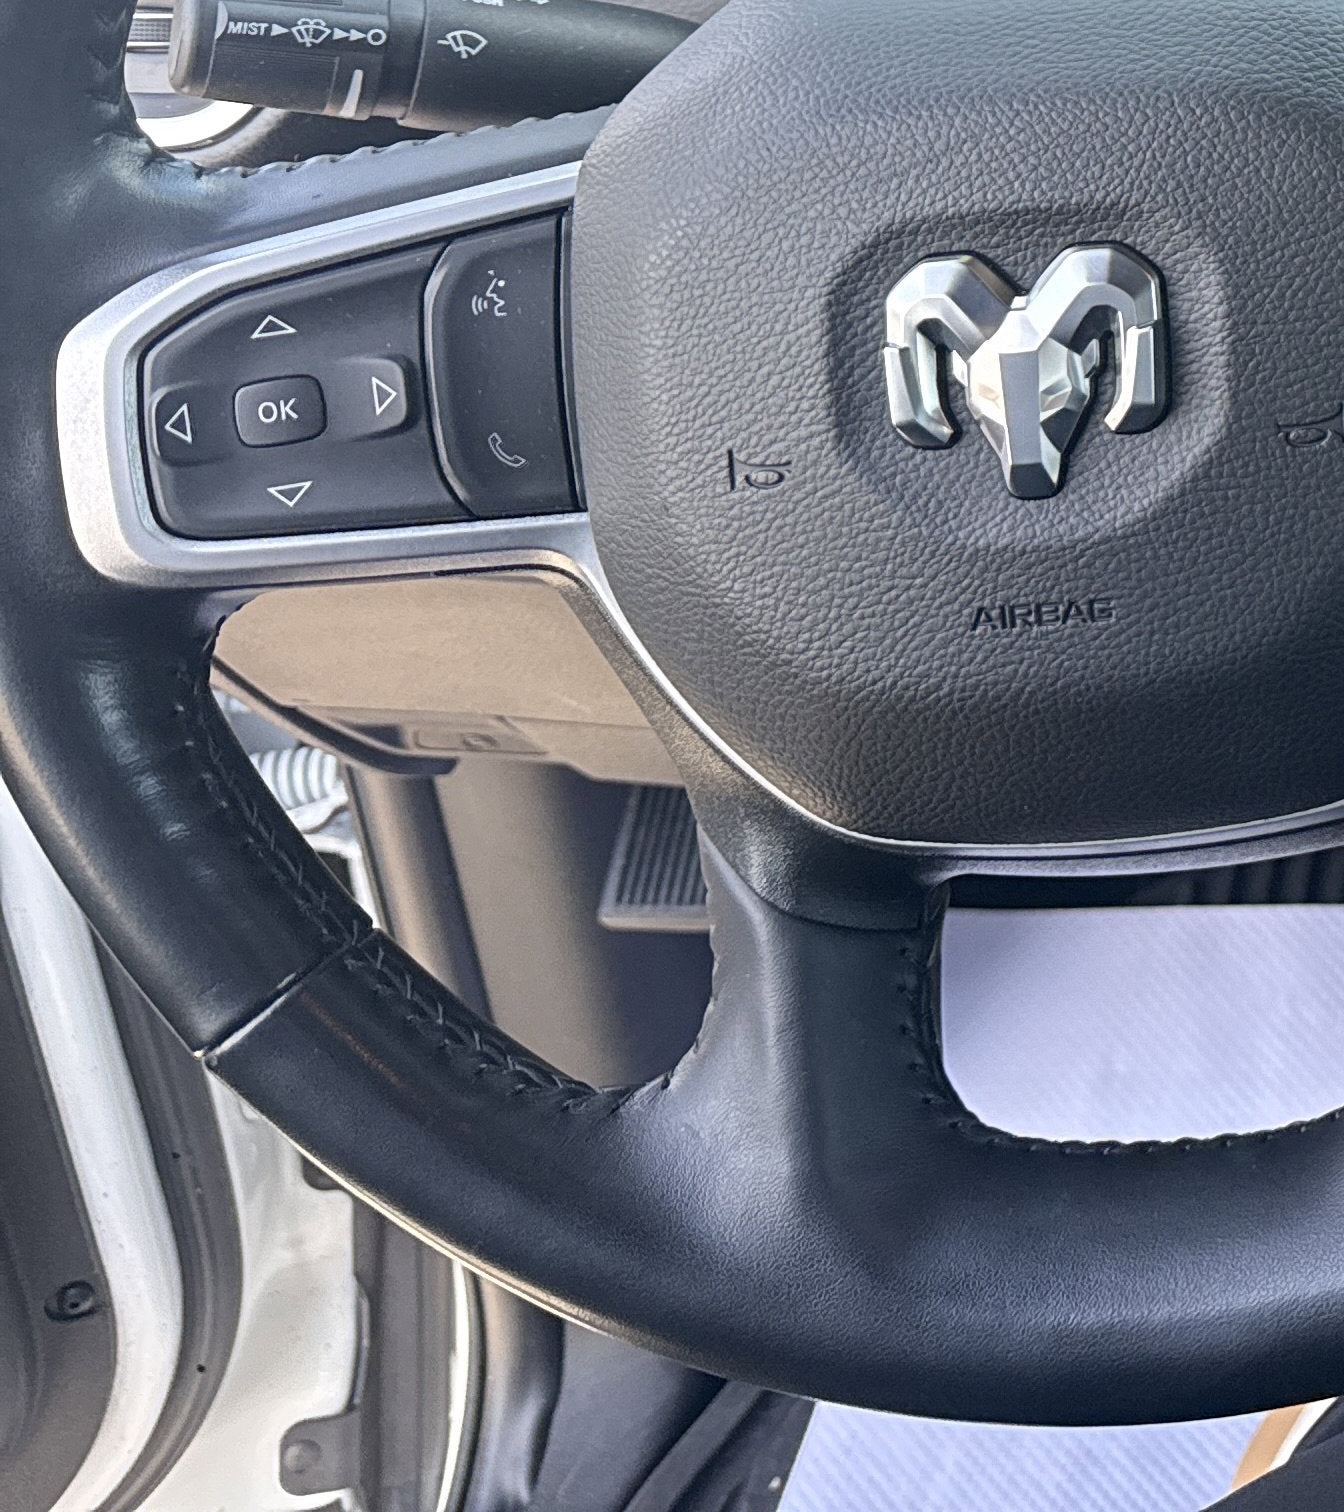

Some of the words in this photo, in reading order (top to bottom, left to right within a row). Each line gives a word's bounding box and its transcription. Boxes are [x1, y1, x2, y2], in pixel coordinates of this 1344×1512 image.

[227, 20, 269, 36] MIST
[258, 398, 299, 424] OK
[970, 596, 1117, 633] AIRBAG
